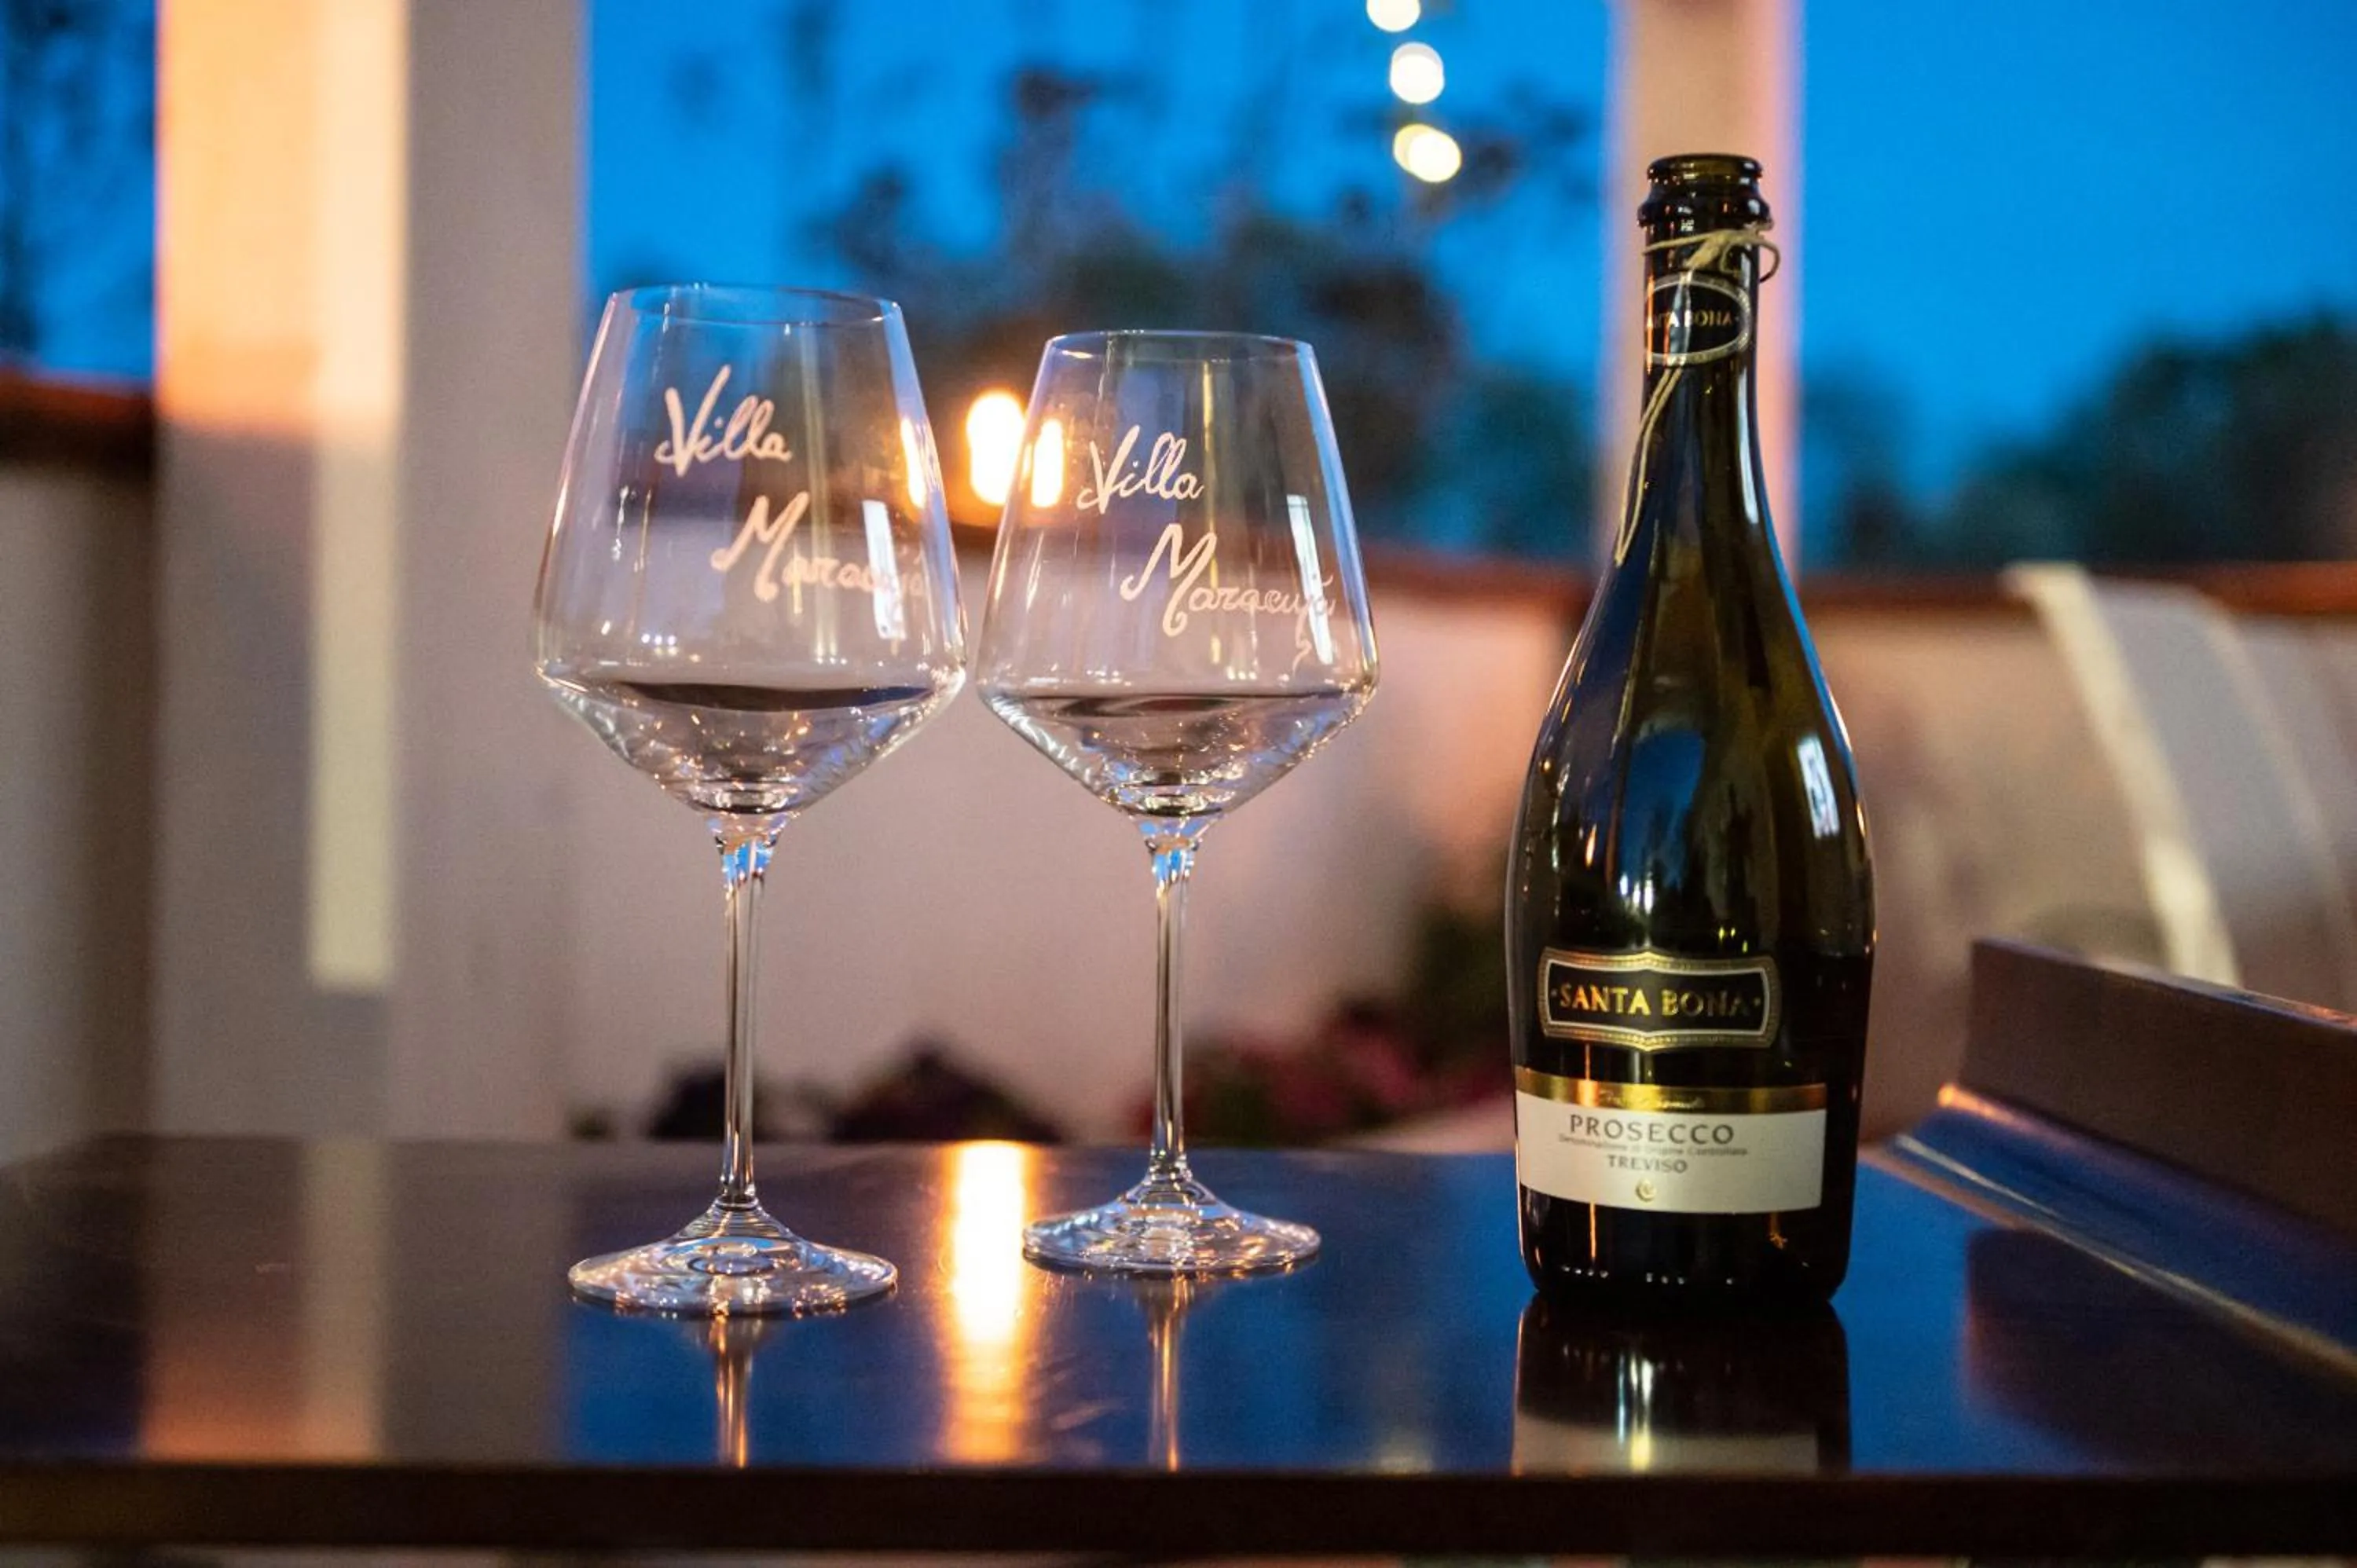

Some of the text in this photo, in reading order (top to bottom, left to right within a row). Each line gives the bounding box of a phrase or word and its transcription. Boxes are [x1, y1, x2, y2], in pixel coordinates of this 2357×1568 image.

[654, 364, 792, 477] Villa
[1076, 424, 1204, 515] Villa
[1560, 982, 1651, 1017] SANTA
[1569, 1113, 1735, 1145] PROSECCO
[1607, 1154, 1689, 1174] TREVISO
